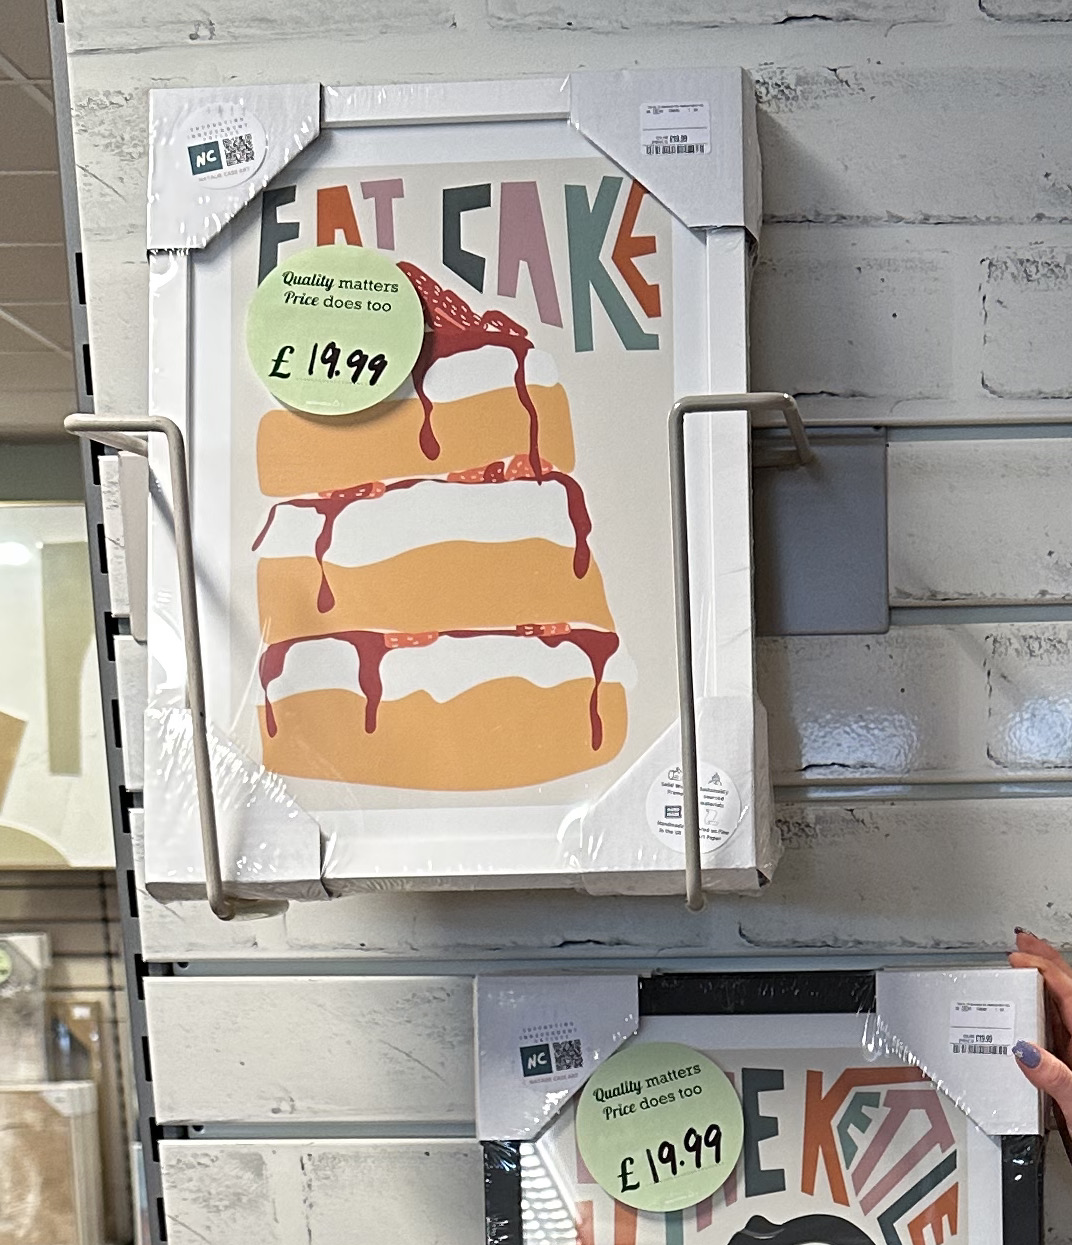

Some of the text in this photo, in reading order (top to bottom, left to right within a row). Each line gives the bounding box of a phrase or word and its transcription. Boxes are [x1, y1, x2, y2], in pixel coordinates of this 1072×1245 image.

[196, 149, 217, 168] NC
[442, 175, 663, 353] CAKE
[282, 270, 399, 294] Quality matters
[283, 290, 392, 313] Price does too
[527, 1052, 548, 1070] NC
[593, 1064, 702, 1103] Quality matters
[603, 1085, 703, 1121] Price does too
